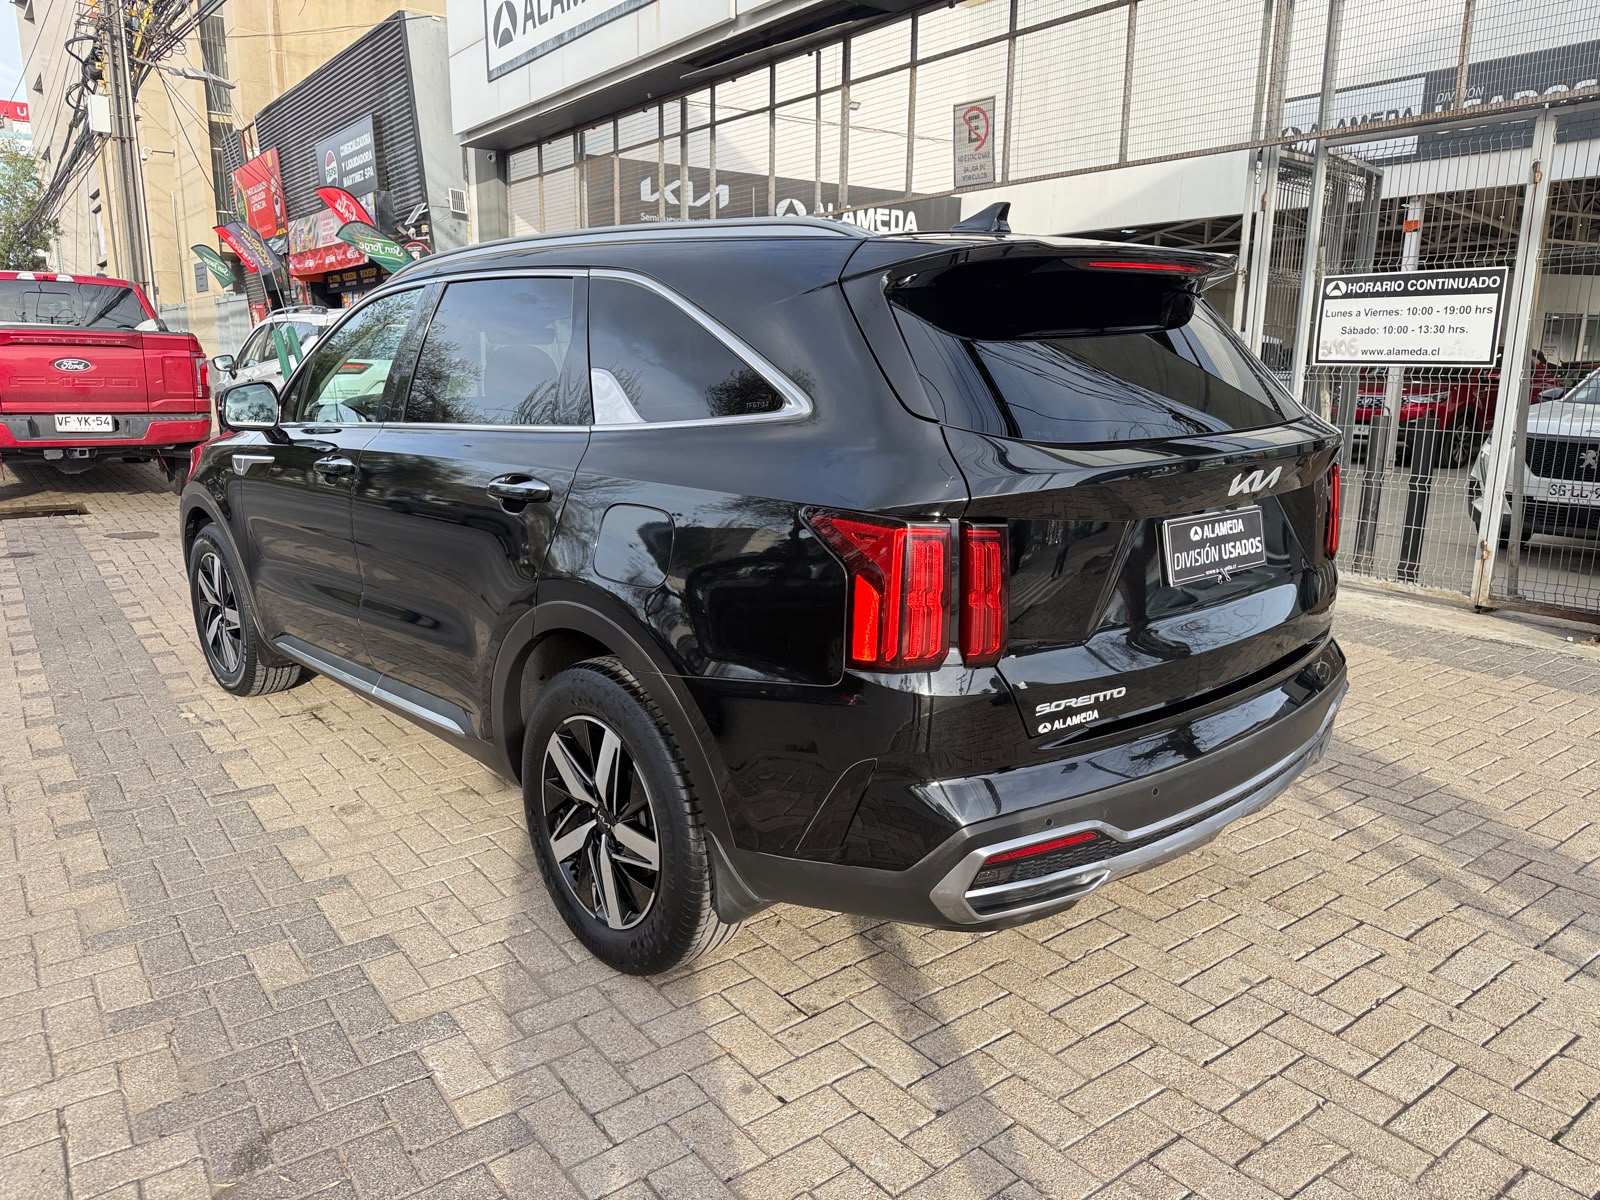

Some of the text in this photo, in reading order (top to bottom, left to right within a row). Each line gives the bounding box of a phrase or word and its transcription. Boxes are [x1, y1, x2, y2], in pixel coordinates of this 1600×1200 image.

[1347, 275, 1500, 294] HORARIO CONTINUADO
[1325, 309, 1353, 318] Lunes
[1364, 307, 1403, 317] Viernes:
[1406, 306, 1434, 316] 10:00
[1443, 305, 1472, 315] 19:00
[1475, 305, 1494, 314] hrs
[1341, 325, 1379, 335] Sábado:
[1382, 325, 1409, 335] 10:00
[1418, 324, 1446, 334] 13:30
[1448, 324, 1469, 334] hrs.
[1360, 347, 1440, 356] www.alameda.cl
[60, 360, 86, 371] Ford
[1227, 466, 1283, 497] KIA
[1203, 518, 1244, 539] ALAMEDA
[1174, 536, 1263, 571] DIVISIÓN USADOS
[1035, 686, 1127, 717] SORENTO
[1052, 709, 1099, 731] ALAMEDA
